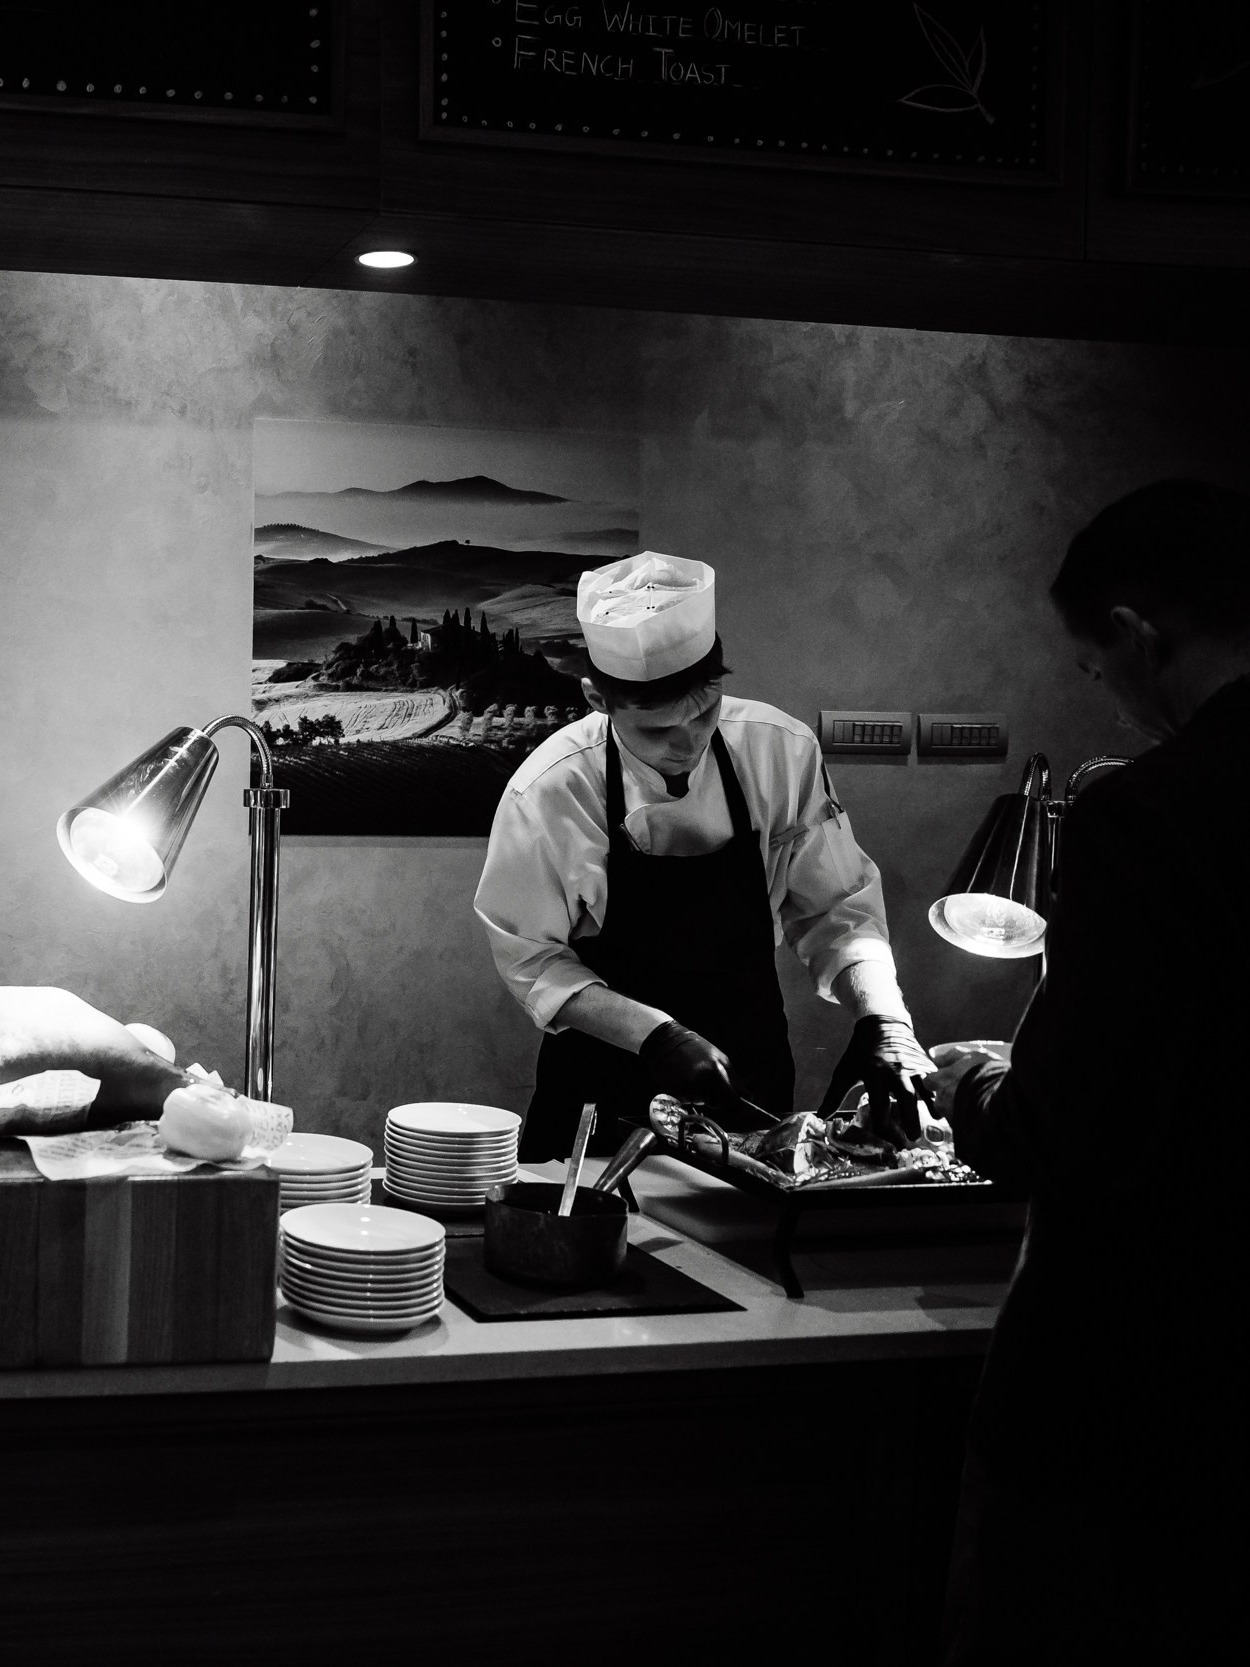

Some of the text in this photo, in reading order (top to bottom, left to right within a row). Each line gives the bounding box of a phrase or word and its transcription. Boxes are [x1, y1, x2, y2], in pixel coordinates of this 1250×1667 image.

[603, 0, 694, 38] WHITE
[703, 7, 806, 47] OMELET
[514, 34, 731, 85] FRENCH TOAST
